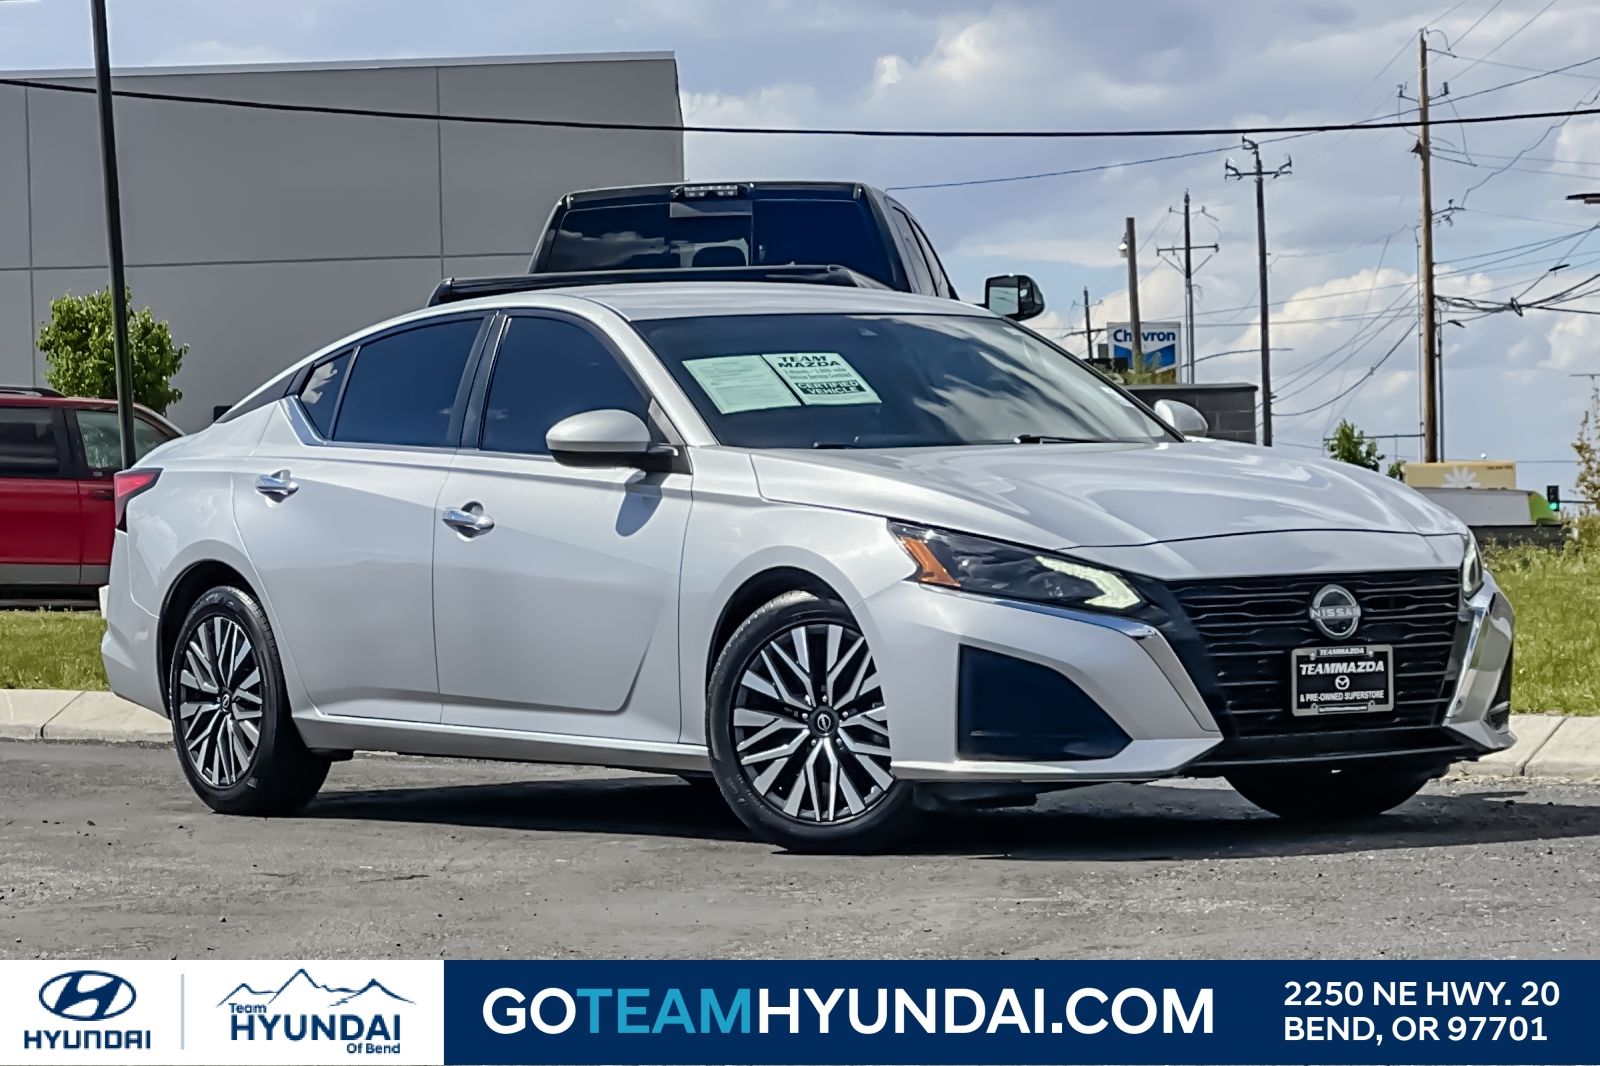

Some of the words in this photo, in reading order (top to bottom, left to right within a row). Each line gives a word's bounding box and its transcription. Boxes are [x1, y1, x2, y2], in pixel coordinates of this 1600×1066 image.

[1113, 329, 1176, 342] Chvron
[797, 380, 859, 389] CERTIFIED
[808, 386, 860, 394] VEHICLE
[1310, 606, 1361, 619] NISSAN
[1319, 647, 1365, 656] TEAMMAZDA
[1300, 661, 1385, 675] TEAMMAZDA
[1300, 694, 1305, 703] &
[1306, 692, 1343, 702] PRE-OWNED
[1344, 690, 1385, 700] SUPERSTORE
